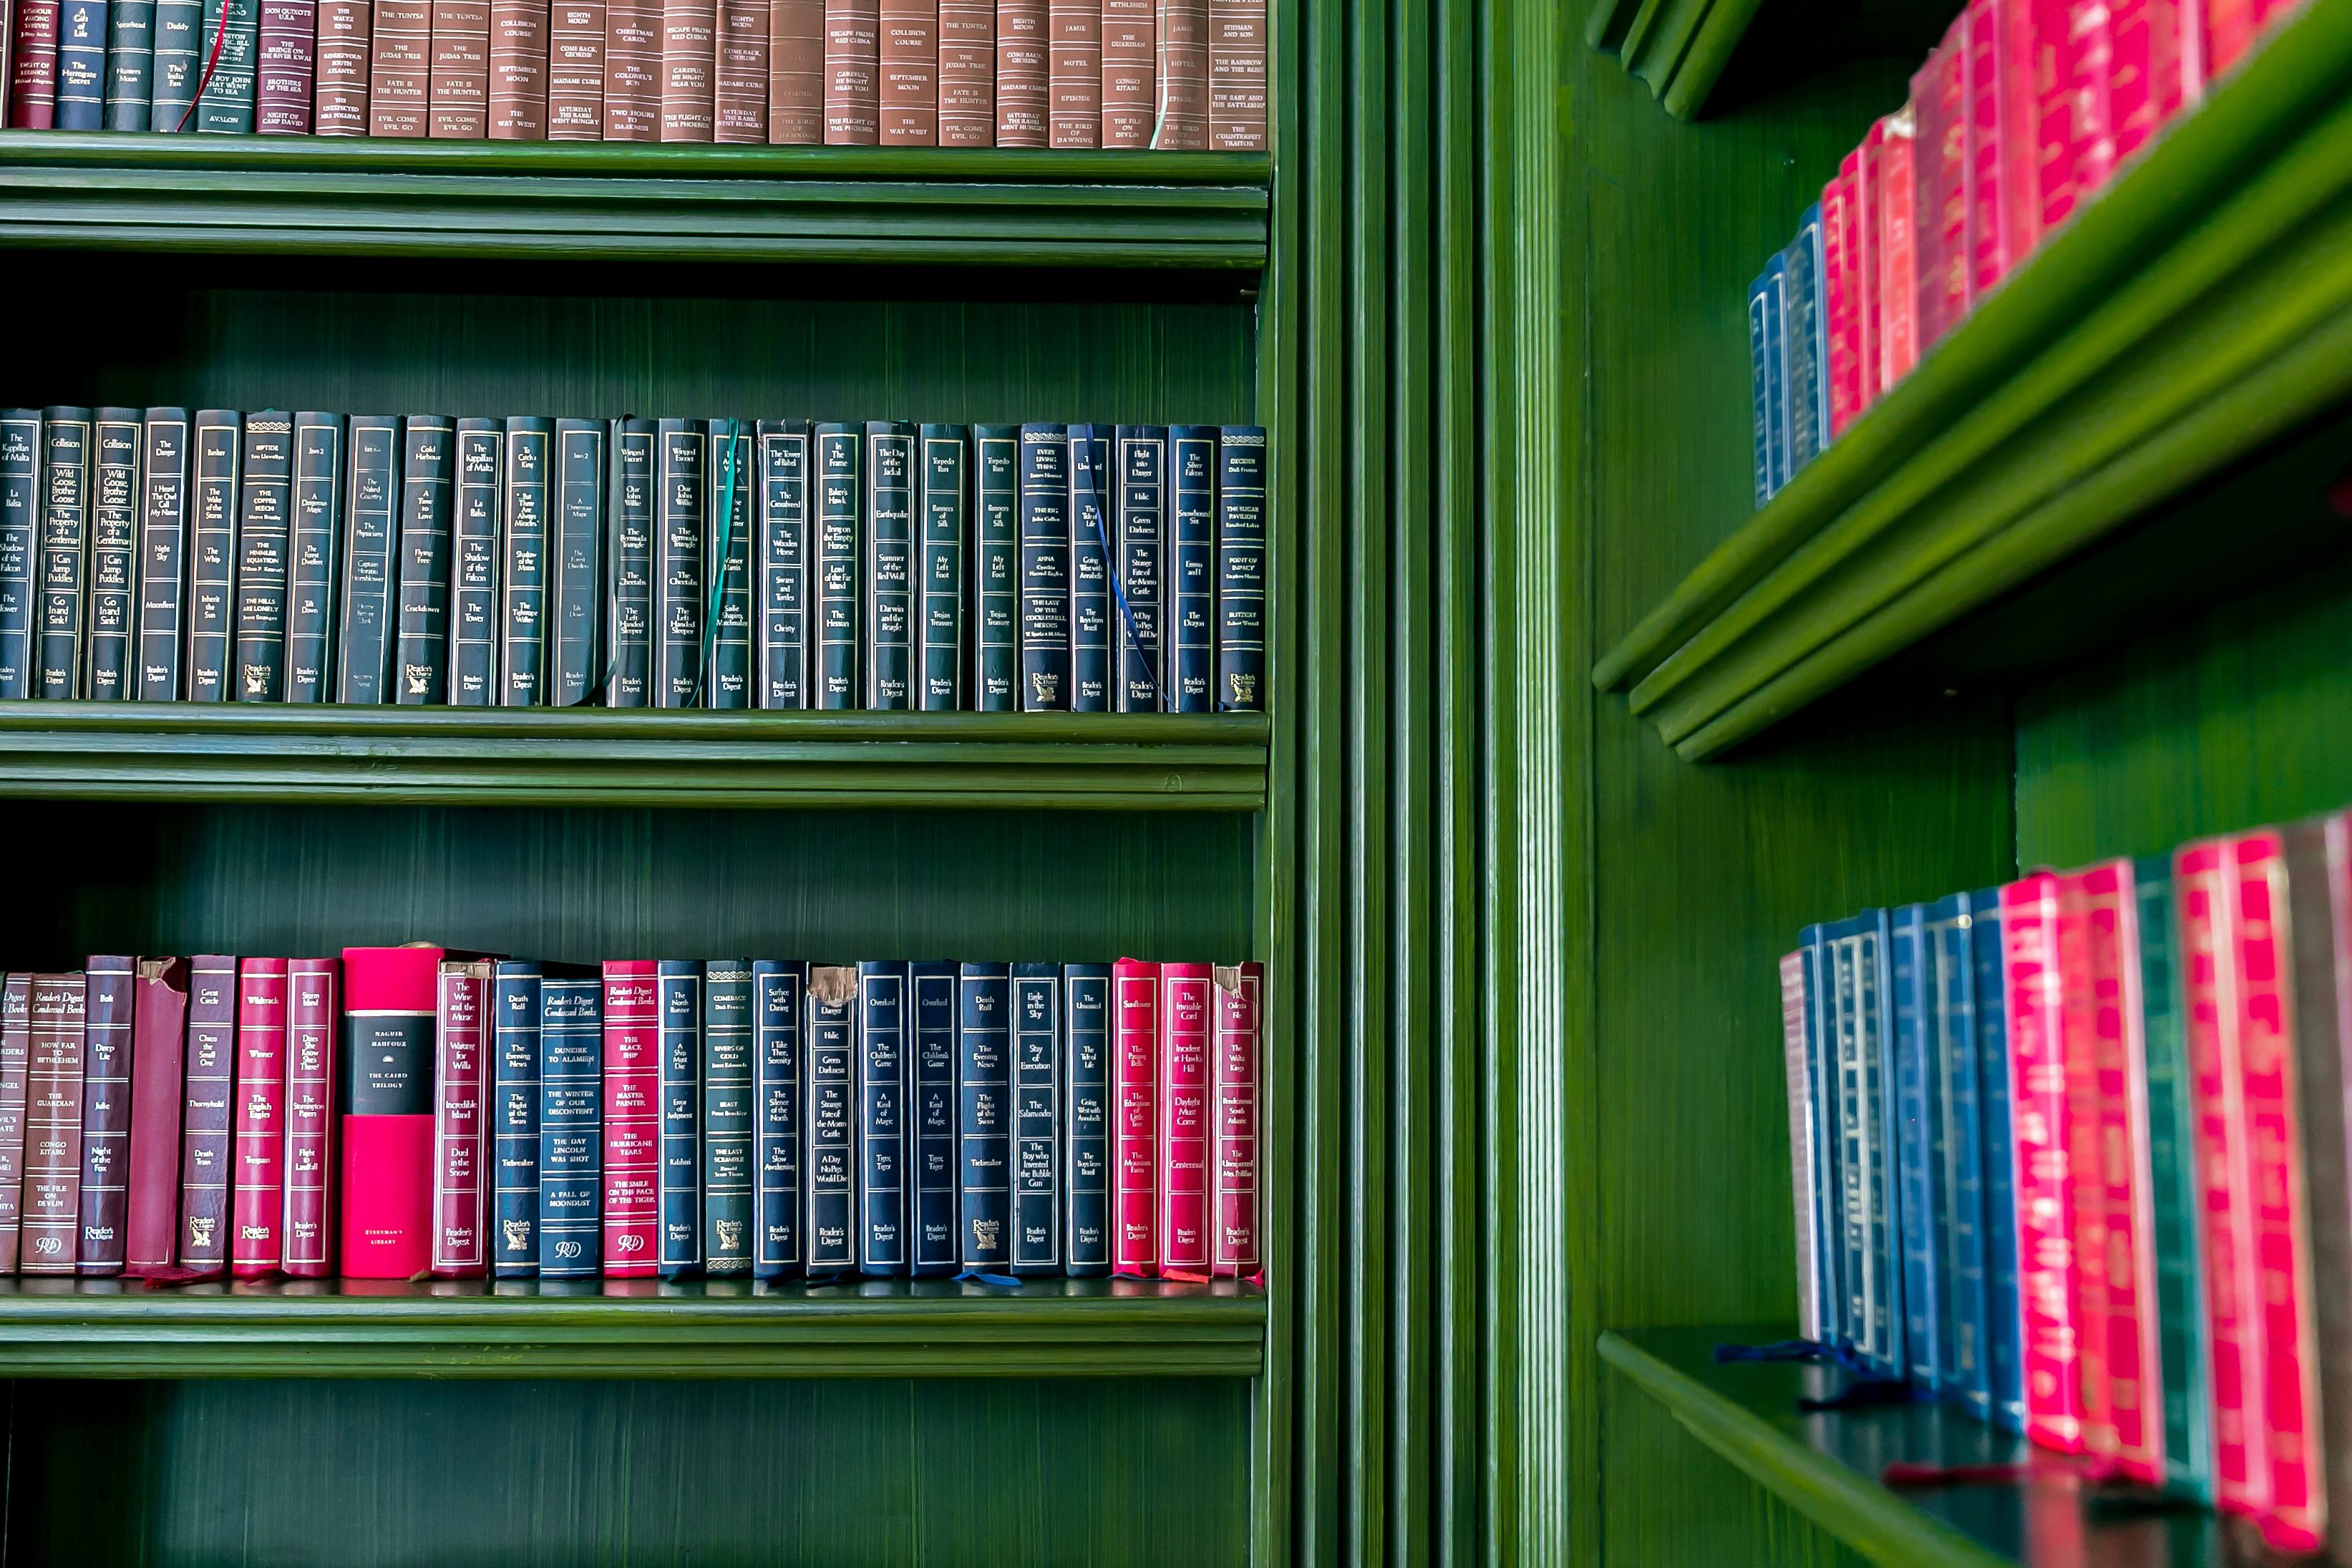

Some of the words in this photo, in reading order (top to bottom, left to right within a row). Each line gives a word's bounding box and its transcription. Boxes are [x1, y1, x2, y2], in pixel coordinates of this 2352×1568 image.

[56, 469, 74, 477] Wild
[52, 486, 76, 497] Brother
[50, 517, 78, 530] Property
[937, 555, 948, 565] My
[52, 564, 71, 574] Jump
[53, 596, 65, 605] Go
[468, 603, 482, 612] The
[465, 613, 484, 622] Tower
[774, 624, 795, 633] Christy
[456, 983, 470, 991] The
[574, 996, 593, 1006] Digest
[578, 1007, 596, 1016] Books
[457, 1051, 467, 1059] for
[37, 1055, 78, 1066] BETHLEHEM
[37, 1100, 74, 1109] GUARDIAN
[452, 1110, 470, 1119] Island
[1023, 1151, 1034, 1161] Boy
[447, 1237, 470, 1247] Digest
